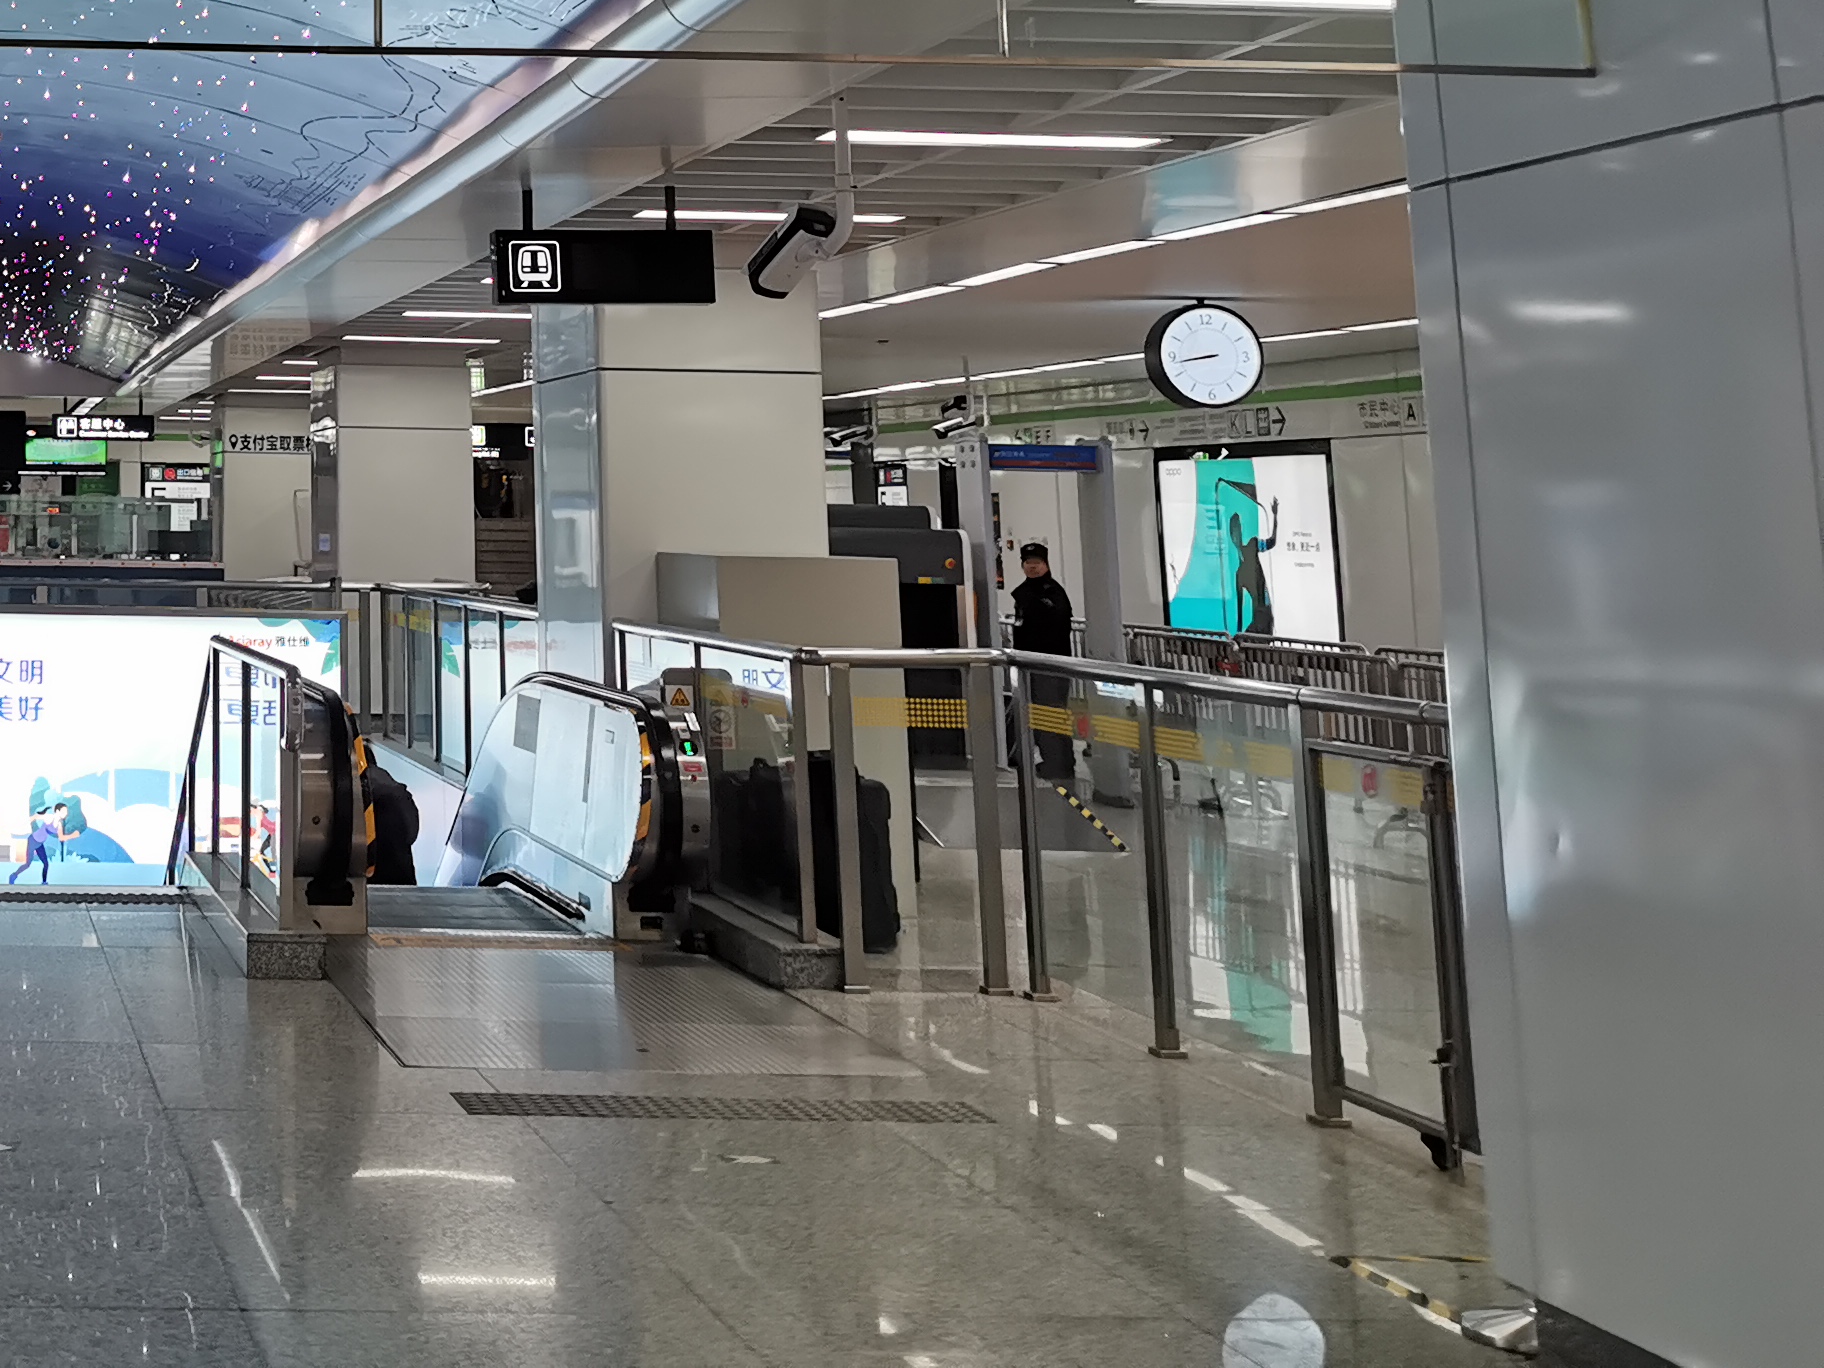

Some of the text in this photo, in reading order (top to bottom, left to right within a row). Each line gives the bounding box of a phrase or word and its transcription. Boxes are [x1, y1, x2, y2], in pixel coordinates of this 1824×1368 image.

[1199, 314, 1213, 325] 12
[1167, 350, 1177, 363] 9
[1241, 351, 1251, 363] 3
[1208, 389, 1217, 401] 6
[1406, 402, 1416, 422] A
[79, 418, 125, 430] 客服中心
[275, 635, 310, 648] 雅仕维
